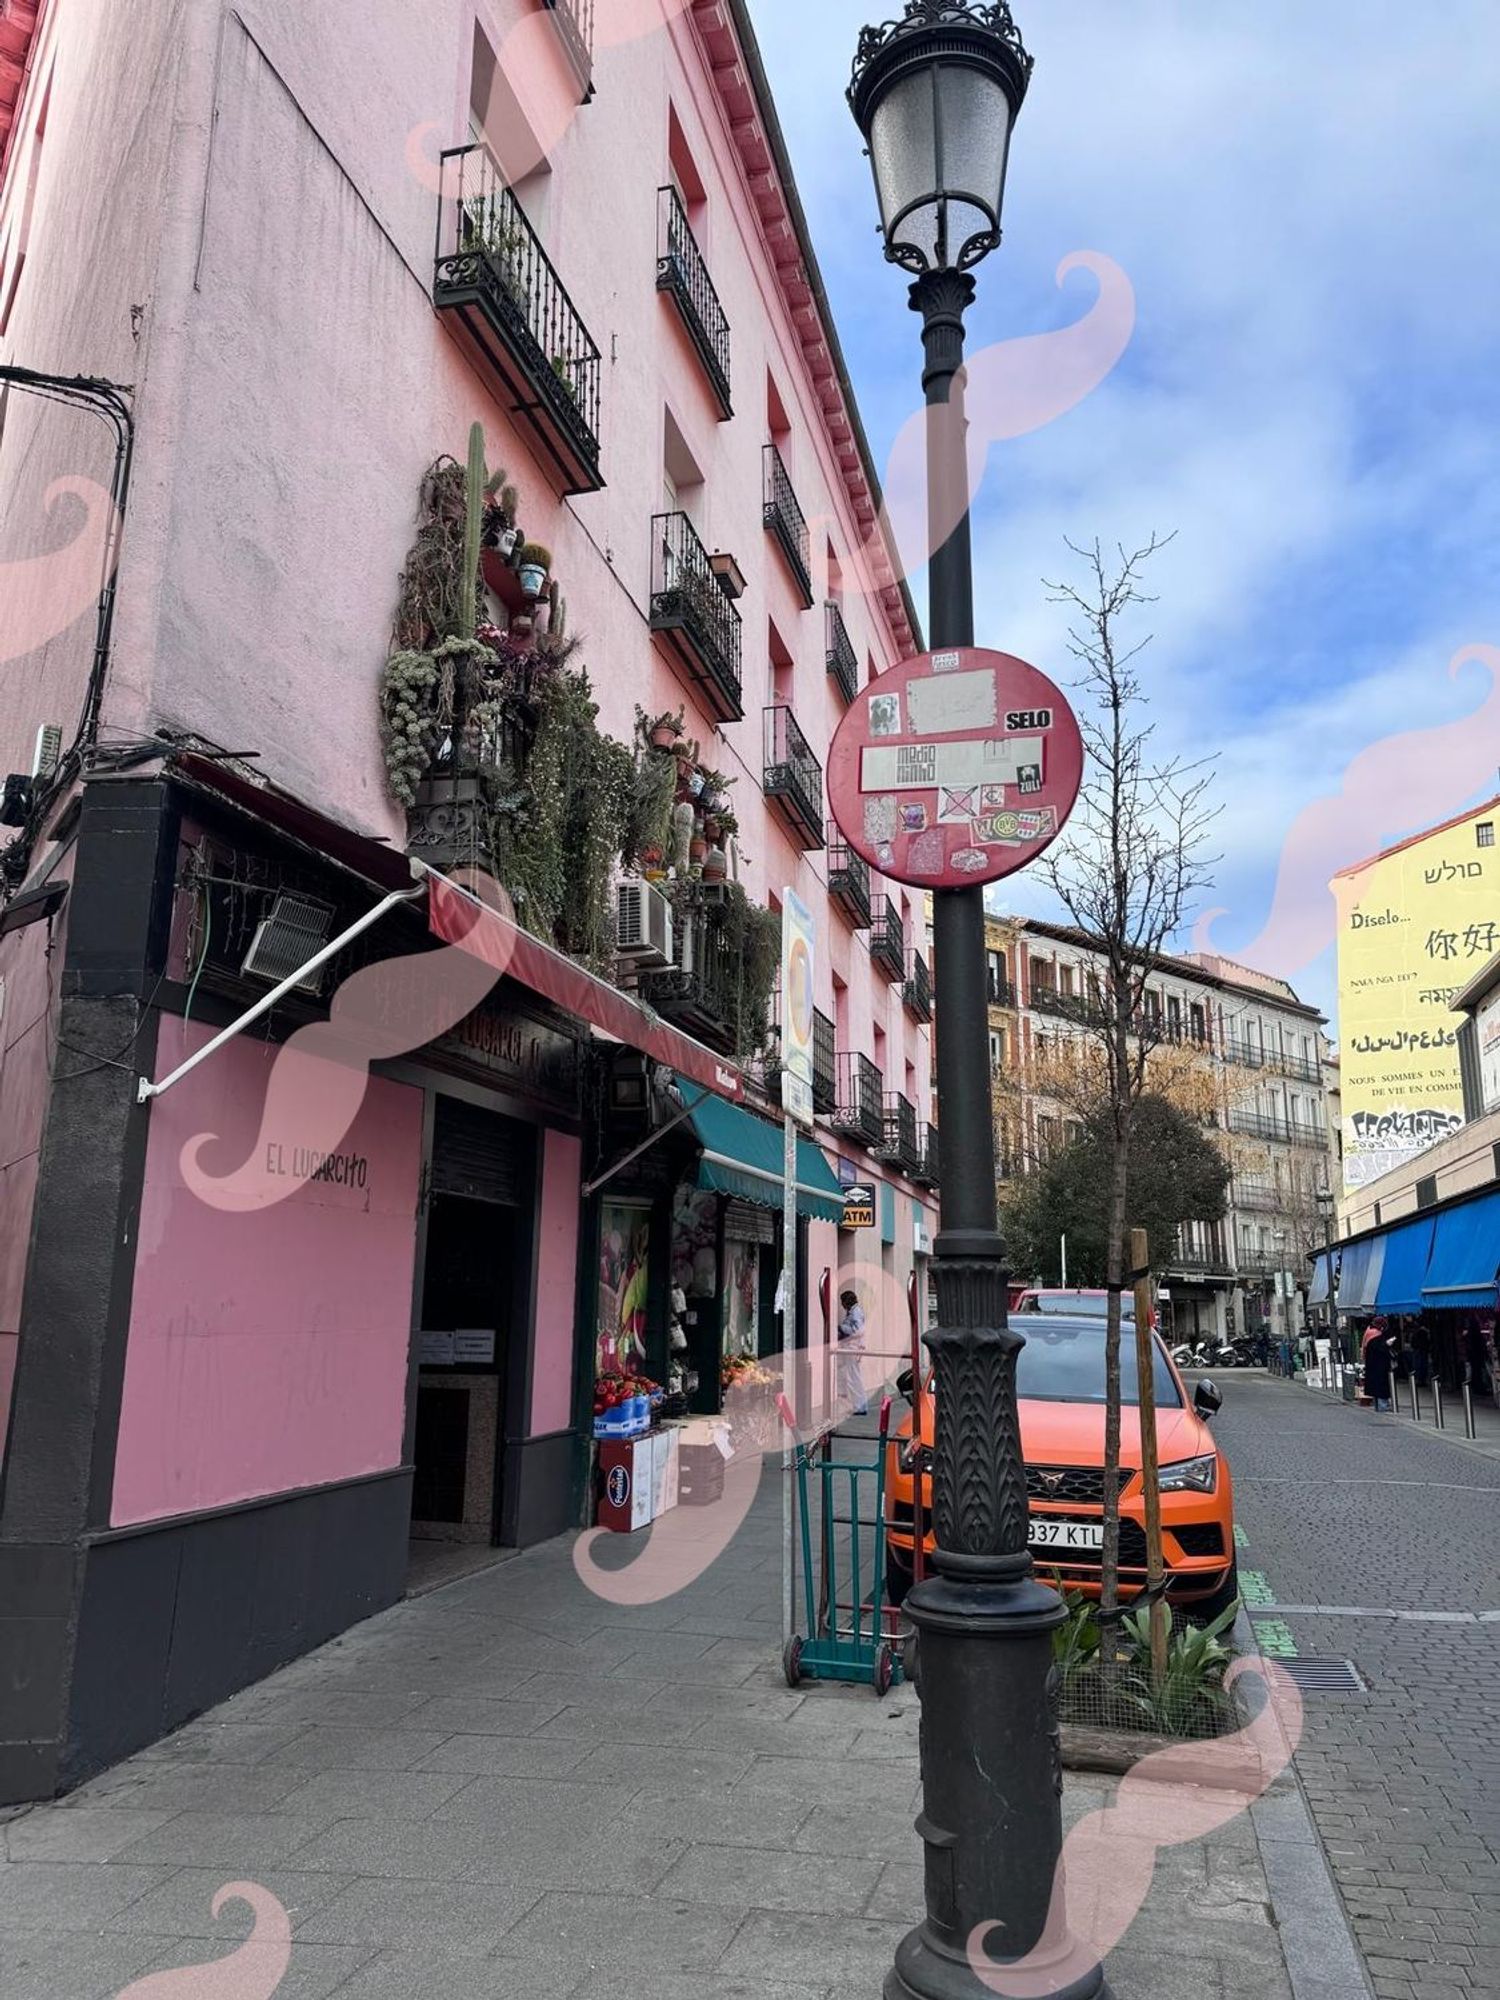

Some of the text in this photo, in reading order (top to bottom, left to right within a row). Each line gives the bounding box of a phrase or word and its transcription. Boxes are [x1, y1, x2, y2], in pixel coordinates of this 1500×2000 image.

[1006, 710, 1050, 730] SELO
[1425, 922, 1500, 960] 你好
[1349, 1077, 1376, 1085] NOUS
[1381, 1071, 1423, 1082] SOMMES
[1429, 1069, 1446, 1078] UN
[1371, 1088, 1385, 1096] DE
[1388, 1086, 1406, 1094] VIE
[1409, 1085, 1423, 1093] EN
[266, 1142, 286, 1175] EL
[843, 1211, 871, 1222] ATM
[1067, 1526, 1102, 1546] KTL
